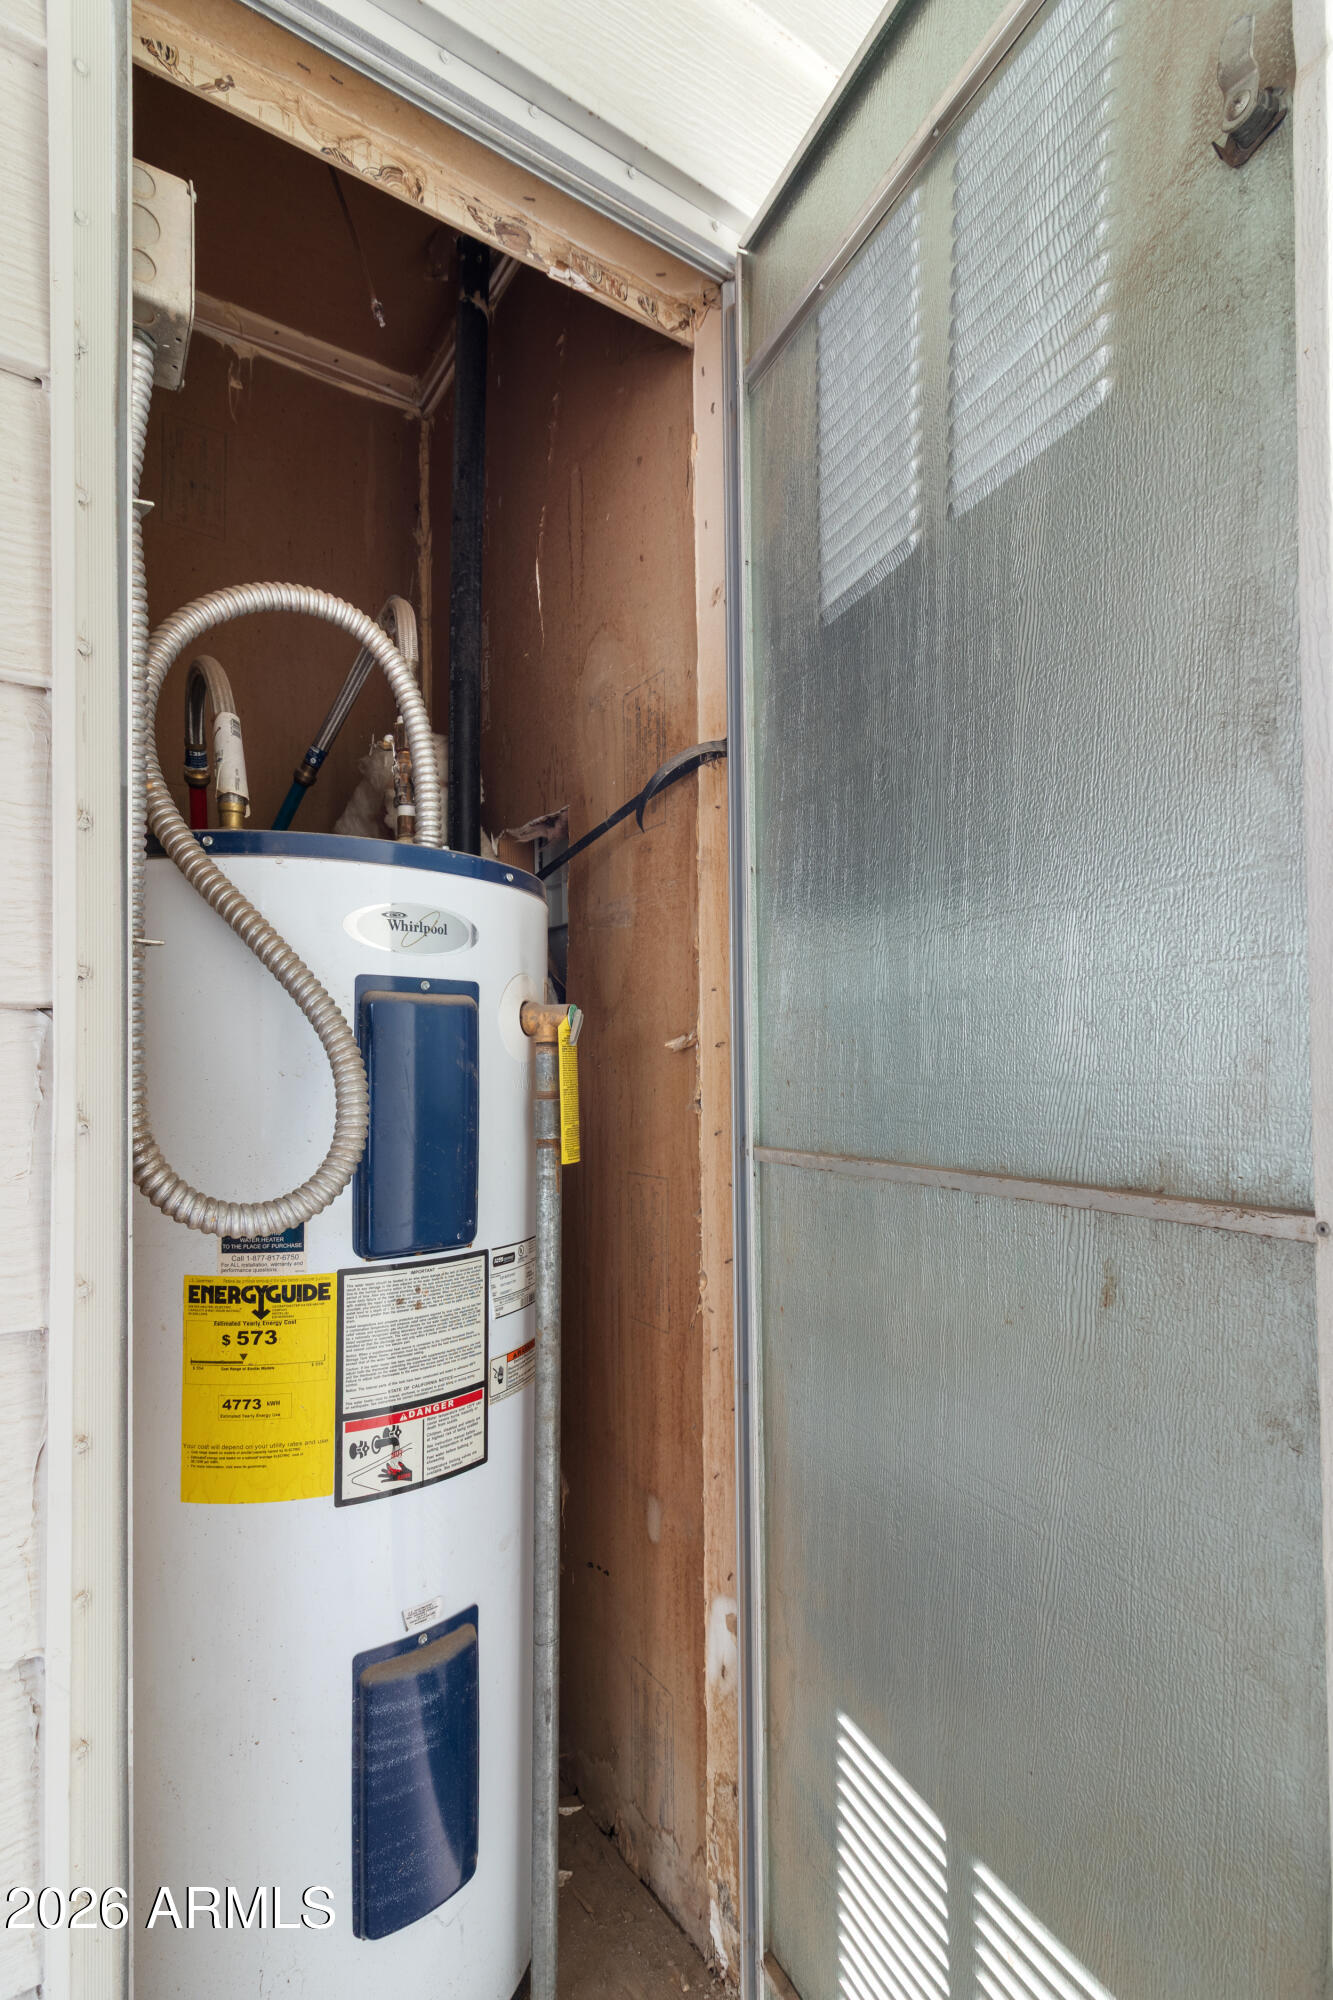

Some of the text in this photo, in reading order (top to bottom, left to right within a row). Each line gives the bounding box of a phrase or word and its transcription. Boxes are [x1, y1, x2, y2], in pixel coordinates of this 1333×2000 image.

[387, 919, 448, 936] Whirlpool
[188, 1282, 331, 1304] ENERGYGUIDE
[243, 1320, 260, 1328] Yearly
[262, 1320, 282, 1328] Energy
[222, 1330, 278, 1347] $ 573
[222, 1399, 262, 1410] 4773
[408, 1400, 454, 1418] DANGER
[221, 1443, 244, 1451] depend
